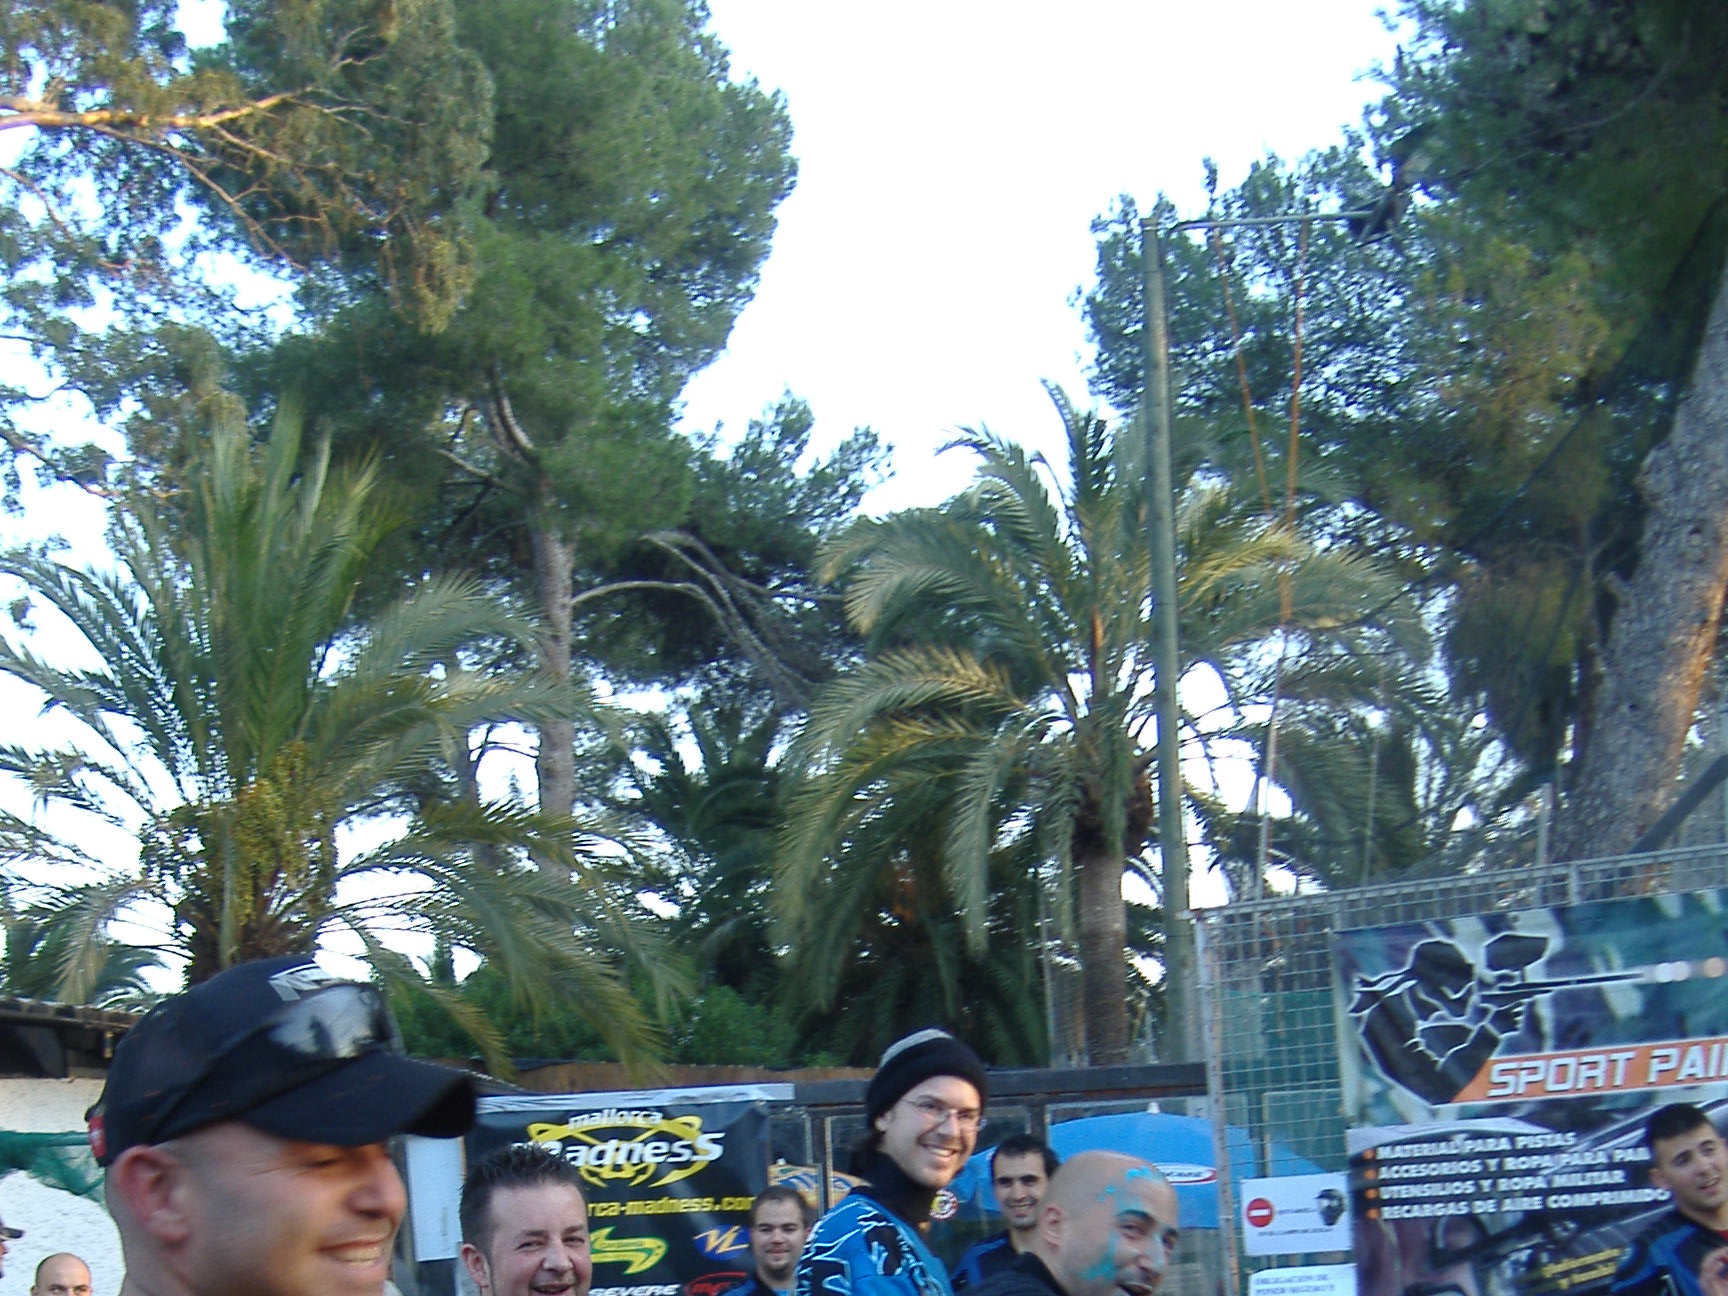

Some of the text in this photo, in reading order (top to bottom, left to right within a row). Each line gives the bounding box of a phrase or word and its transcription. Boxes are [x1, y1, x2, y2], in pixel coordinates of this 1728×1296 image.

[1487, 1042, 1728, 1097] SPORT PAI
[568, 1109, 663, 1130] mallorca
[1375, 1132, 1576, 1160] MATERIAL PARA PISTAS
[1377, 1159, 1482, 1180] ACCESORIOS
[1485, 1158, 1499, 1172] Y
[1502, 1154, 1553, 1171] ROPA
[1559, 1150, 1609, 1166] PARA
[1379, 1170, 1626, 1200] UTENSILIOS Y ROPA MILITAR
[587, 1196, 757, 1217] rca-madness.co
[1380, 1188, 1671, 1220] RECARGAS DE AIRE COMPRIMIDO
